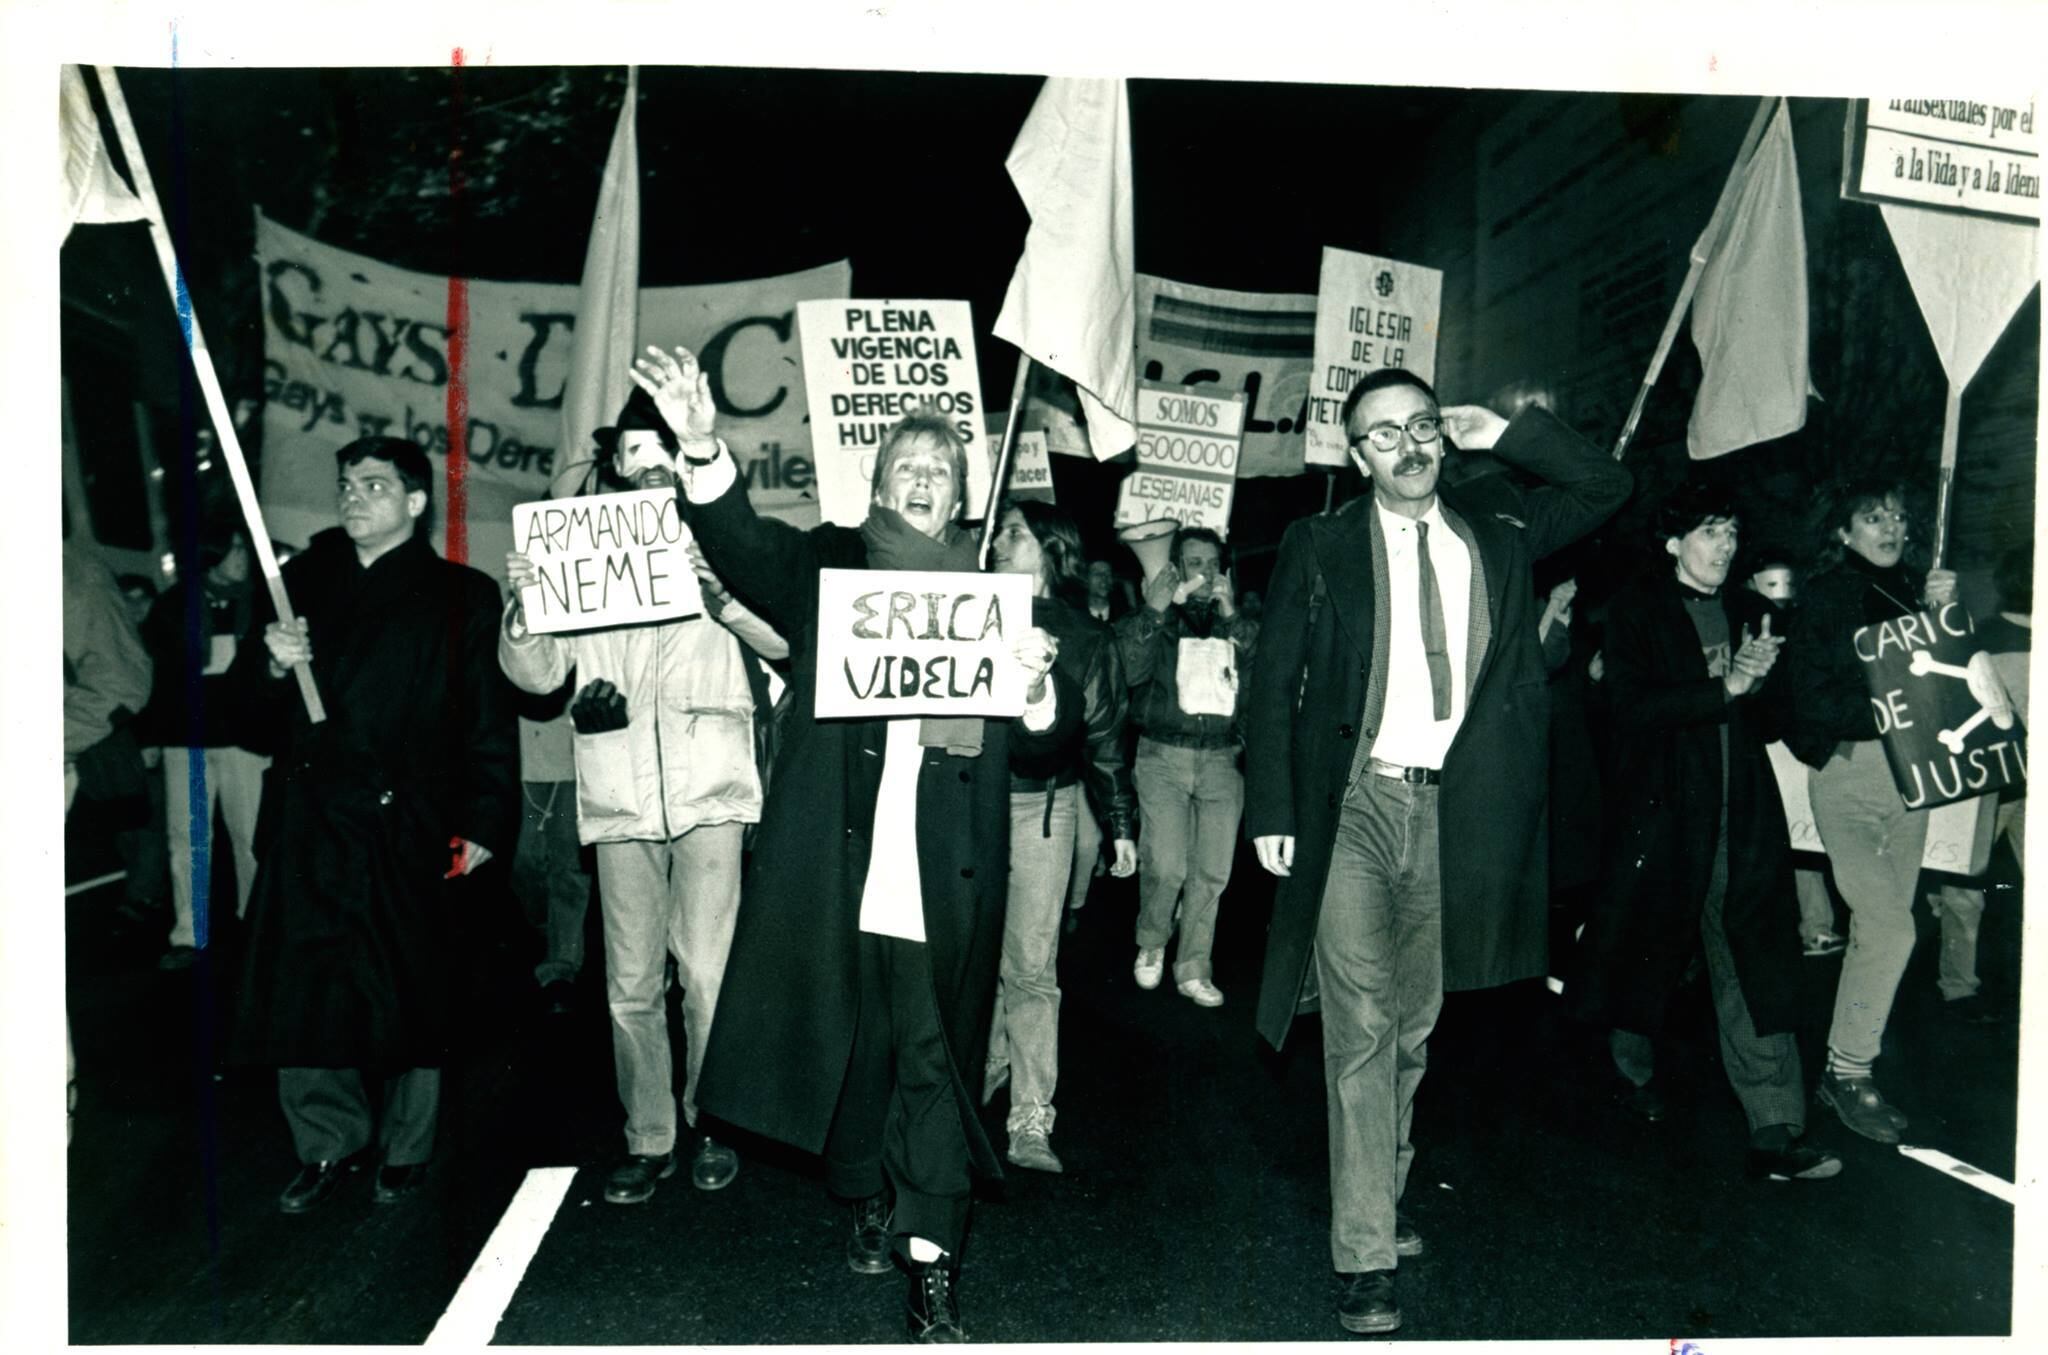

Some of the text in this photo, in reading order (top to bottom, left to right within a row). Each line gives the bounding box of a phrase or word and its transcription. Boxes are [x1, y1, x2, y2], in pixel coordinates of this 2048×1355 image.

[1990, 106, 2017, 138] por
[2021, 101, 2034, 134] el
[1895, 155, 1905, 178] a
[1909, 147, 1924, 181] la
[1927, 149, 1957, 186] Vida
[1957, 165, 1971, 198] y
[1972, 168, 1982, 190] a
[1986, 160, 2001, 193] la
[265, 257, 453, 387] GAYS
[846, 309, 936, 333] PLENA
[1350, 306, 1412, 342] IGLESIA
[831, 336, 962, 360] VIGENCIA
[1352, 340, 1404, 367] DE LA
[852, 362, 949, 386] DE LOS
[1157, 397, 1220, 427] SOMOS
[1130, 475, 1223, 509] LESBIANAS
[526, 497, 682, 555] ARMANDO
[1144, 502, 1155, 522] Y
[537, 549, 671, 616] NEME
[852, 591, 1003, 642] ERICA
[845, 655, 995, 699] VIDELA
[1871, 689, 1913, 734] DE
[1903, 741, 2027, 808] JUSTI
